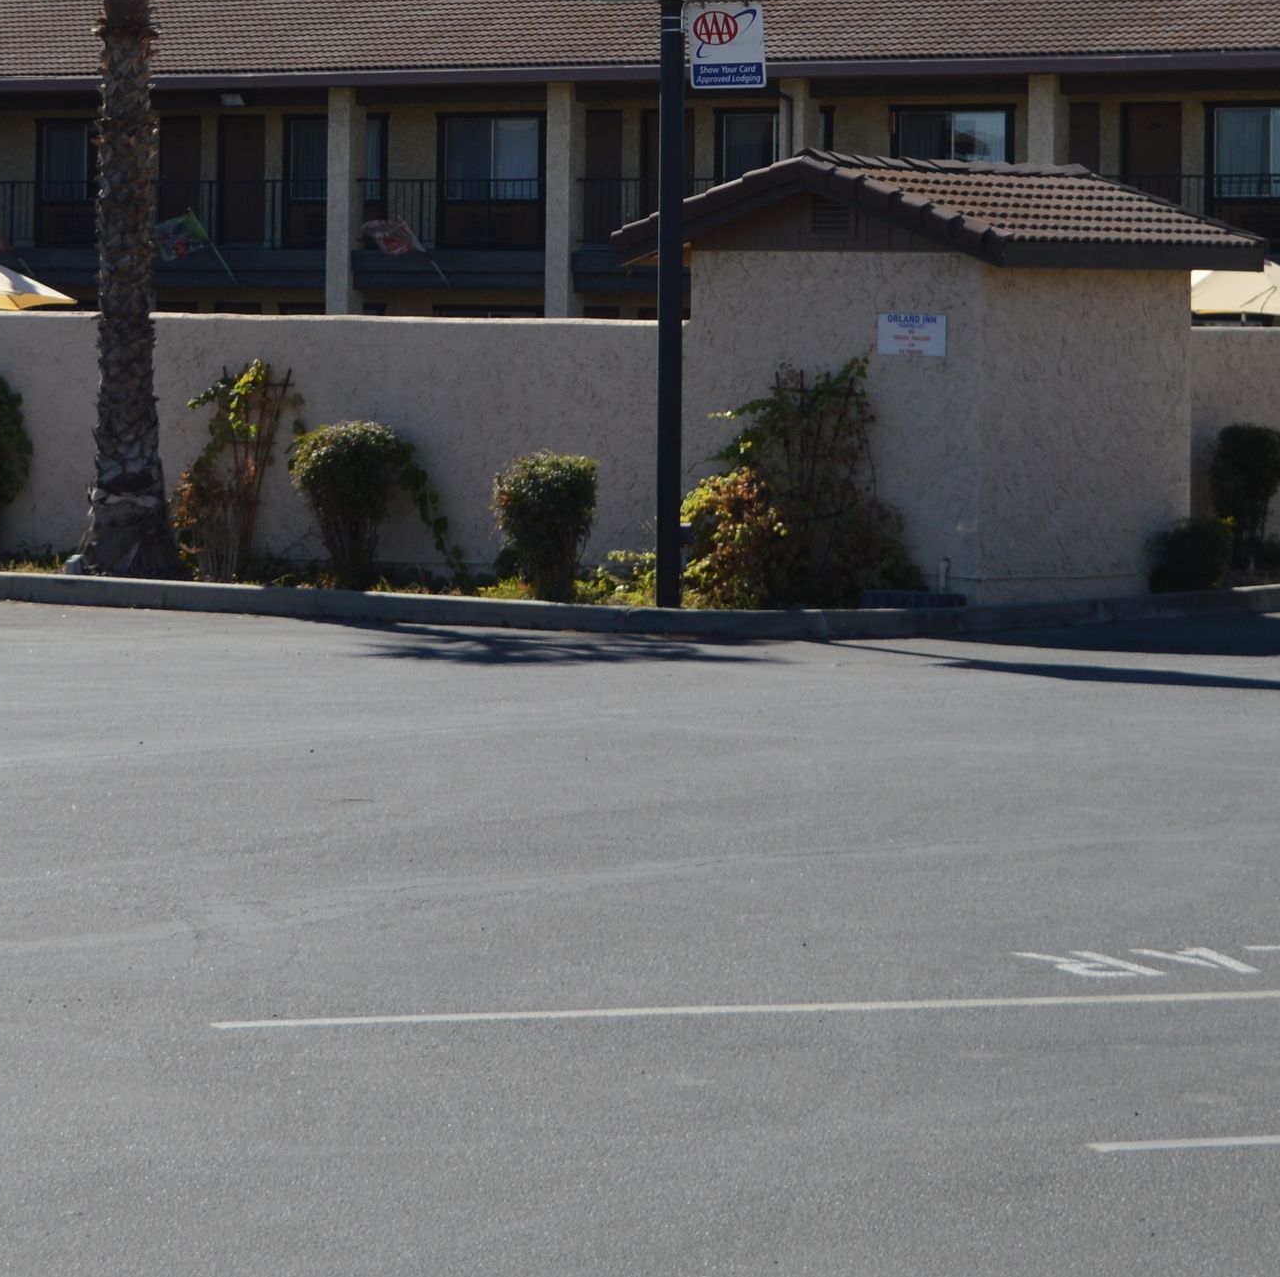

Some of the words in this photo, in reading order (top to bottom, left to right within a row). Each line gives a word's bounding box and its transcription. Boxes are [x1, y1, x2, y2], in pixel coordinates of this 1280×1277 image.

[696, 11, 735, 45] AAA
[699, 66, 720, 75] Show
[721, 65, 738, 74] Your
[740, 64, 756, 74] Card
[696, 75, 731, 85] Approved
[732, 73, 761, 85] Lodging
[887, 314, 920, 323] ORLAND
[922, 315, 937, 324] INN
